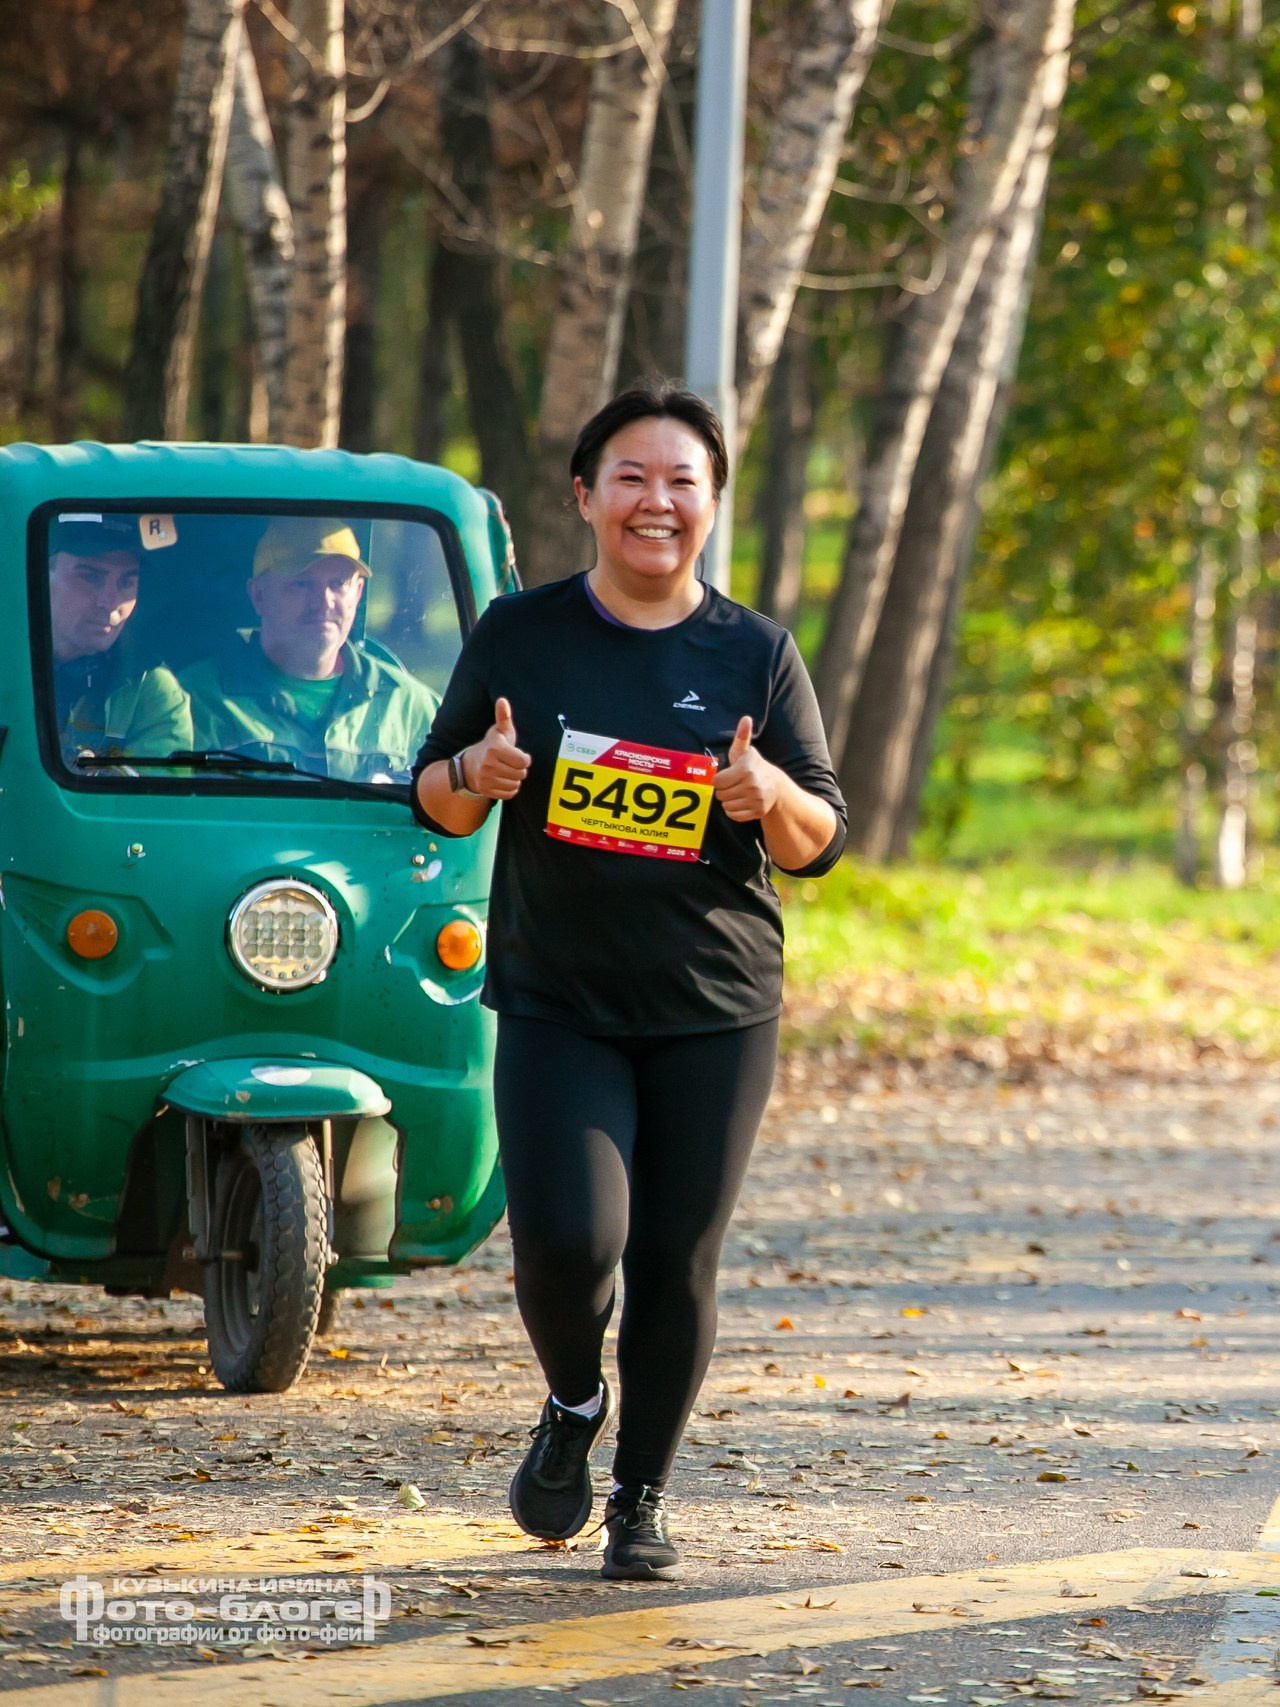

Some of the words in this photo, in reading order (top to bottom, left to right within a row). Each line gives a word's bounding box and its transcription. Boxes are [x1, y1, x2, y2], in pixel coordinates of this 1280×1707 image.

[614, 749, 671, 766] КРАСНОЯРСКИЕ
[628, 758, 655, 769] МОСТЫ
[558, 767, 701, 831] 5492
[581, 817, 637, 834] ЧЕРТЫКОВА
[639, 828, 669, 839] ЮЛИЯ
